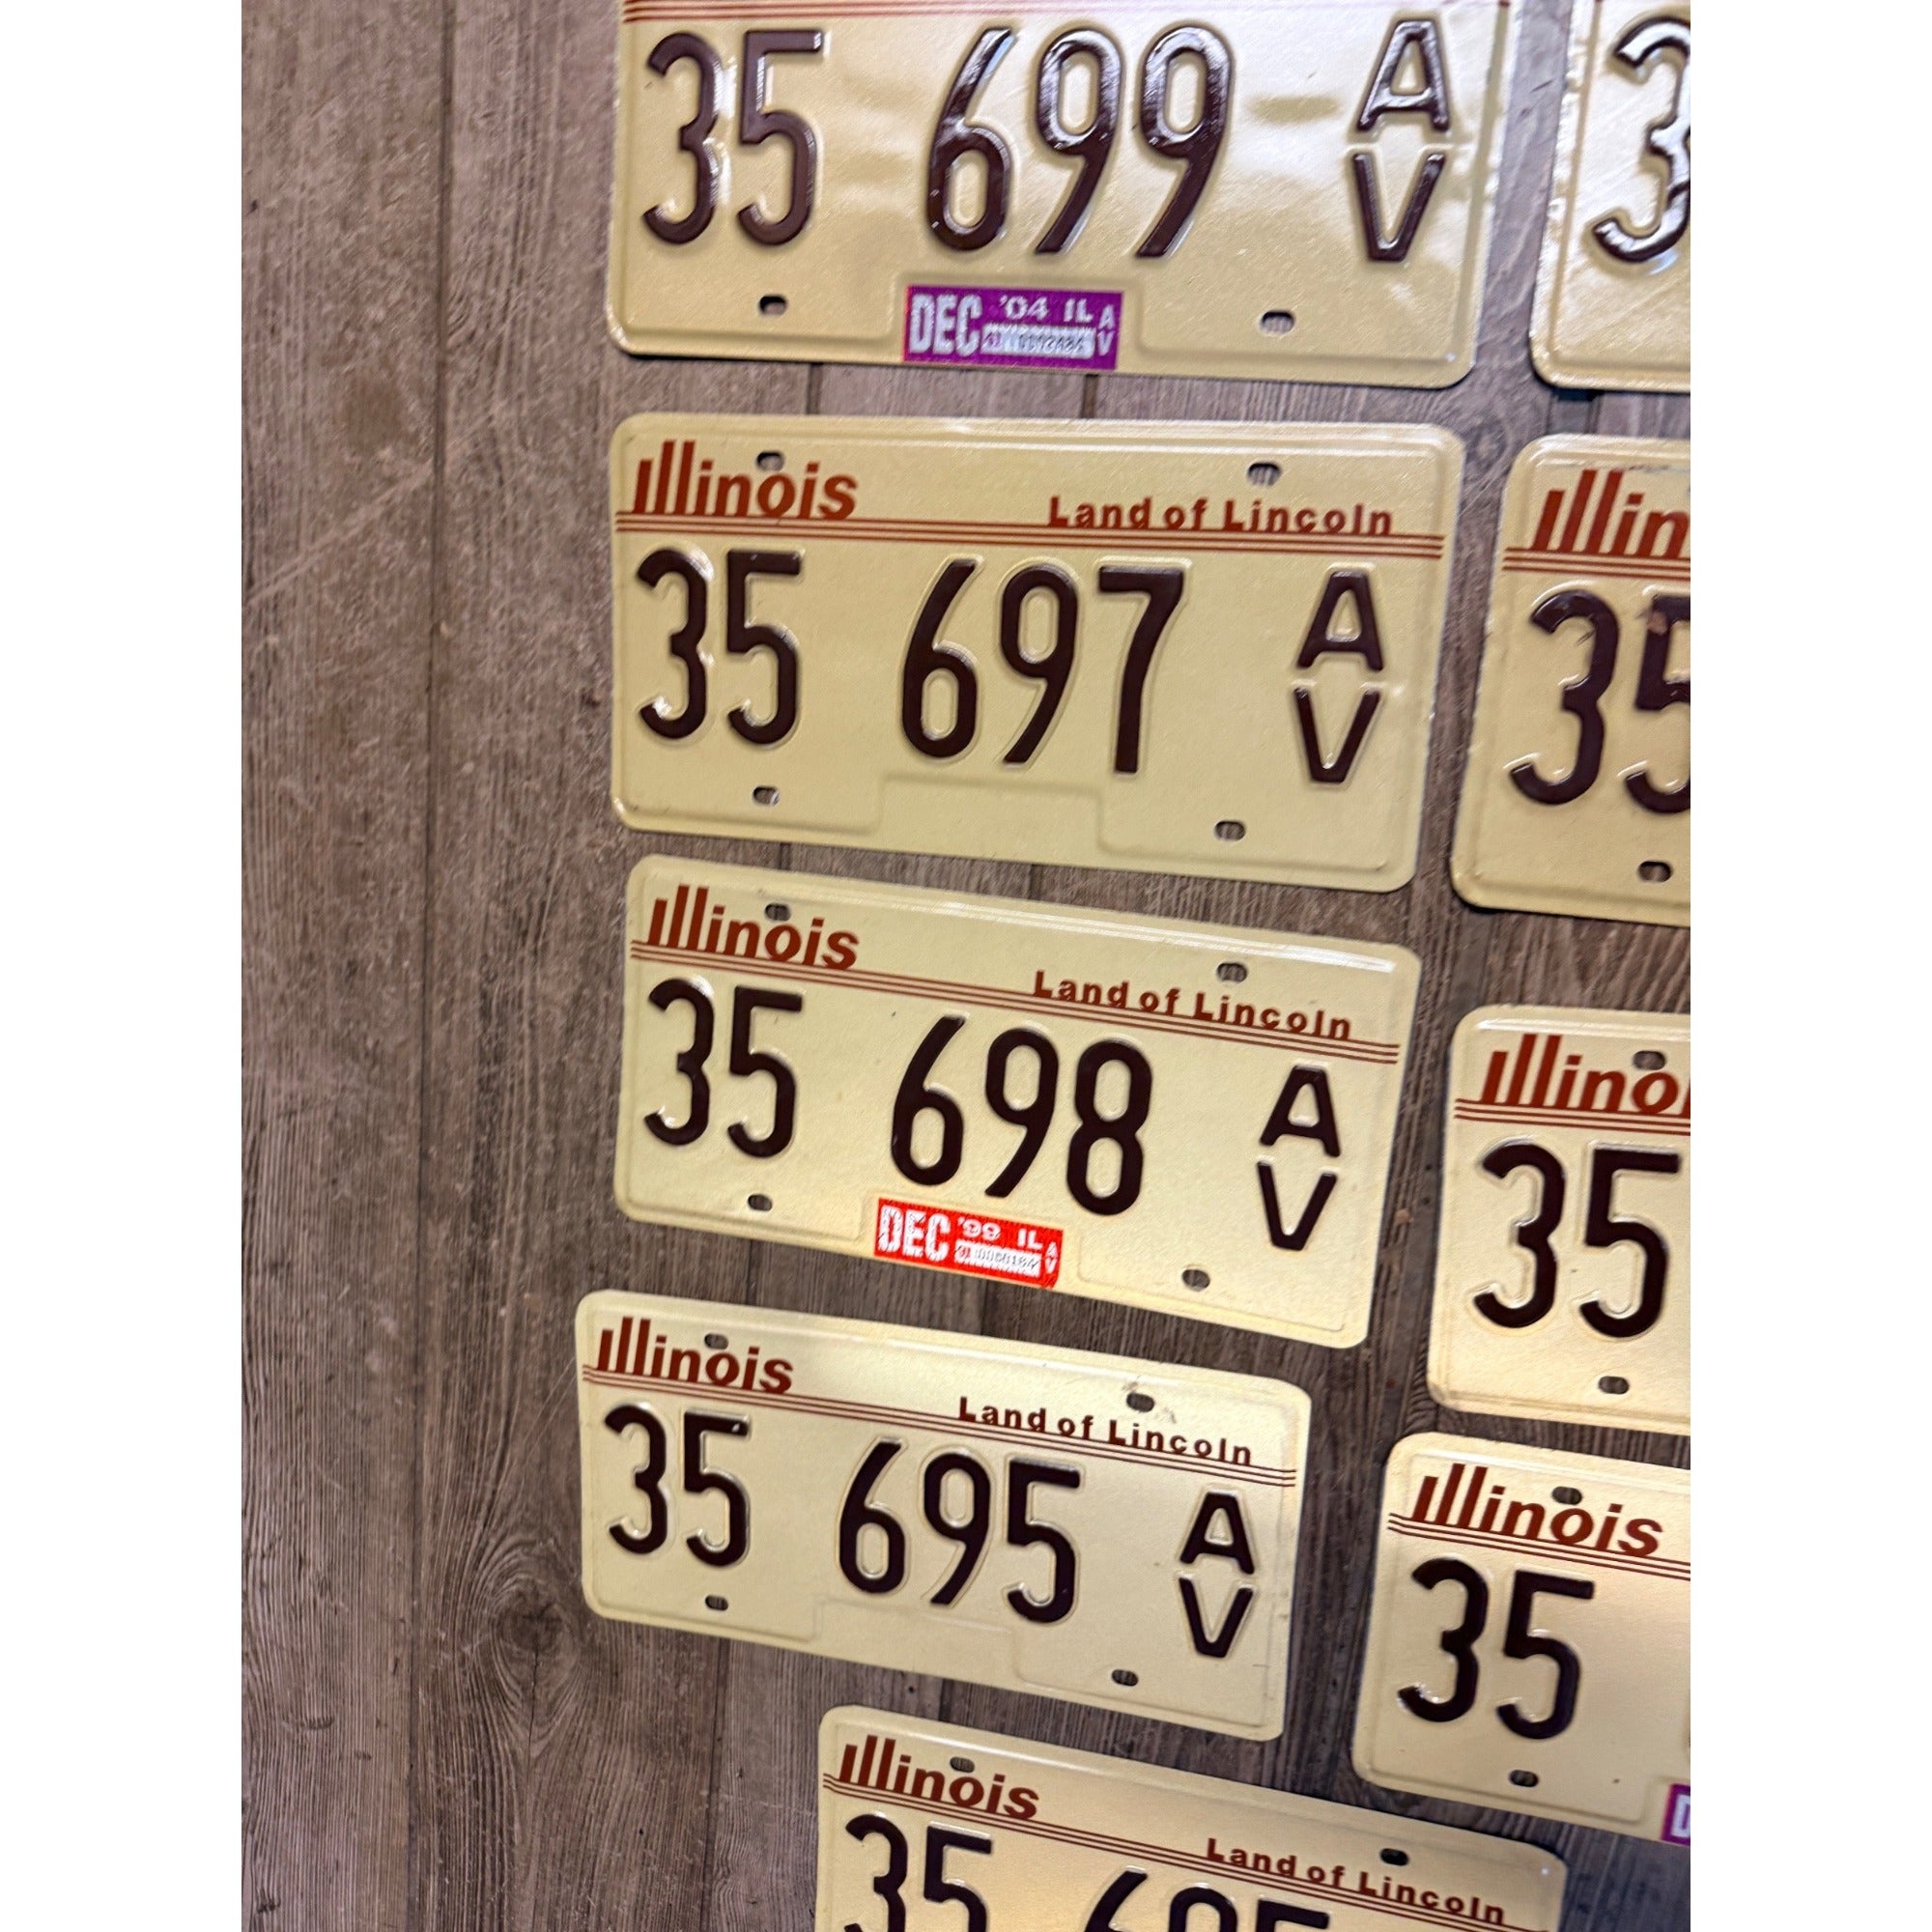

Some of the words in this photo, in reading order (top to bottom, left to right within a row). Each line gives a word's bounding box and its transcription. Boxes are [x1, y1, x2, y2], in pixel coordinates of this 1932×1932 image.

[642, 29, 823, 246] 35
[927, 26, 1233, 257] 699
[909, 294, 982, 356] DEC
[999, 295, 1049, 321] '04
[1064, 298, 1094, 323] IL
[632, 440, 858, 520] Illinois
[1048, 497, 1151, 528] Land
[1164, 498, 1207, 530] of
[1223, 500, 1392, 535] Lincoln
[638, 549, 801, 744] 35
[902, 559, 1184, 773] 697
[1509, 589, 1690, 813] 35
[647, 885, 860, 970] Illinois
[1033, 971, 1128, 1009] Land
[1140, 988, 1181, 1015] of
[1194, 992, 1351, 1040] Lincoln
[644, 978, 803, 1158] 35
[892, 1016, 1152, 1216] 698
[878, 1205, 951, 1262] DEC
[957, 1216, 1001, 1240] '99
[1017, 1229, 1043, 1249] IL
[1473, 1144, 1681, 1338] 35
[596, 1317, 794, 1394] Illinois
[958, 1397, 1046, 1432] Land
[1058, 1415, 1094, 1439] of
[1108, 1420, 1252, 1465] Lincoln
[605, 1405, 749, 1567] 35
[839, 1441, 1080, 1623] 695
[1411, 1463, 1662, 1557] Illinois
[1398, 1558, 1594, 1740] 35
[838, 1735, 1039, 1820] Illinois
[845, 1814, 992, 1931] 35
[1207, 1838, 1295, 1877] Land
[1307, 1865, 1346, 1888] of
[1358, 1871, 1504, 1924] Lincoln
